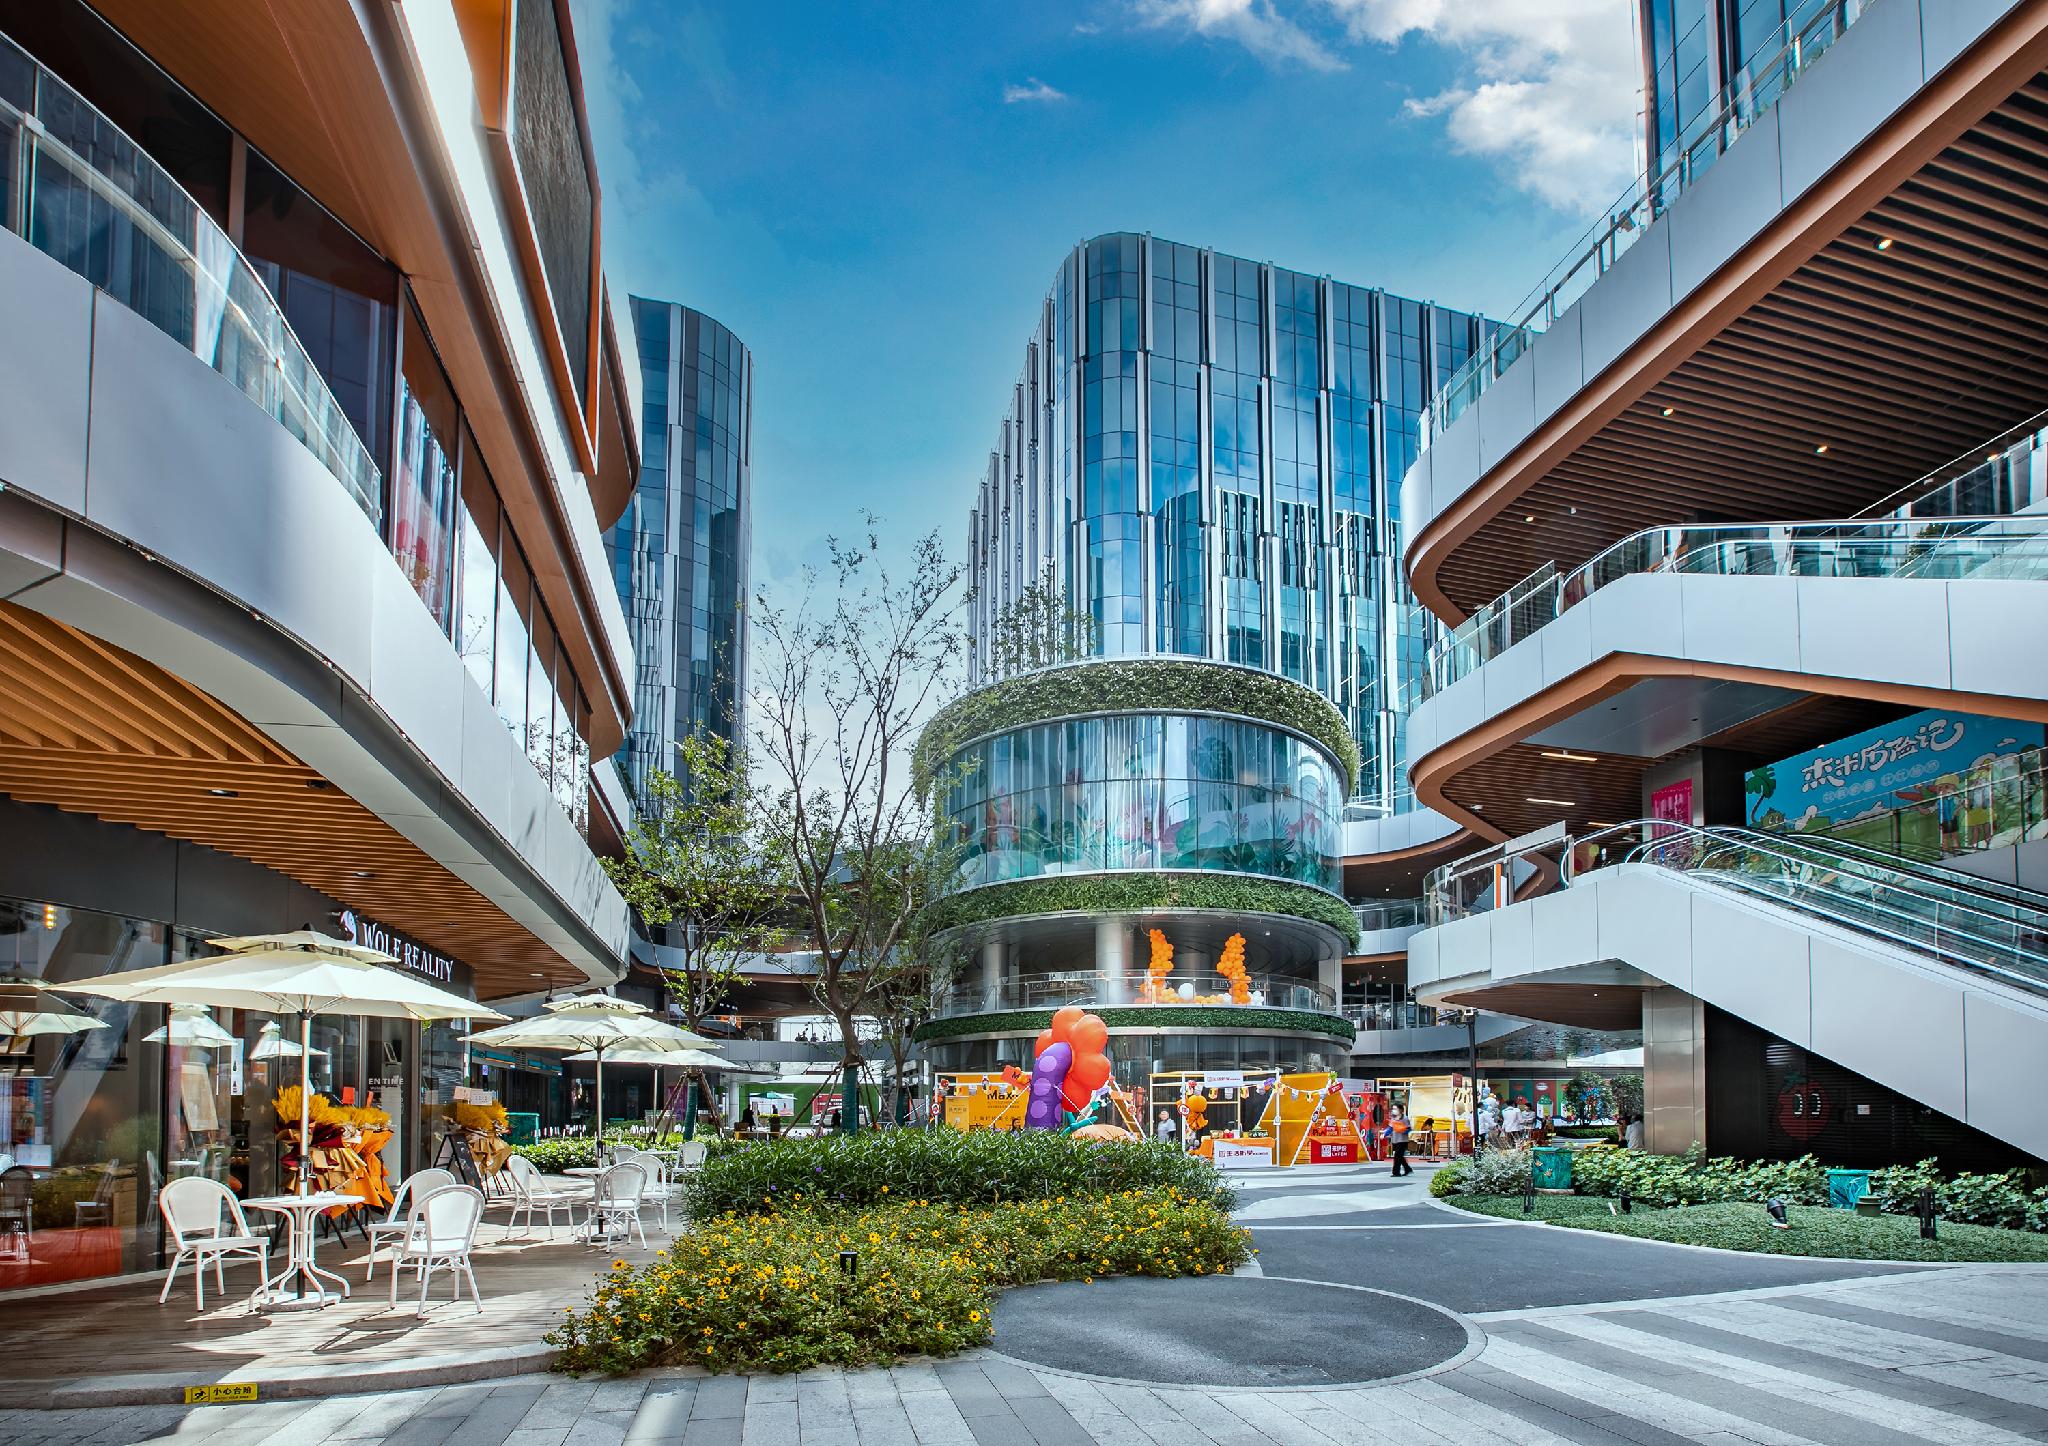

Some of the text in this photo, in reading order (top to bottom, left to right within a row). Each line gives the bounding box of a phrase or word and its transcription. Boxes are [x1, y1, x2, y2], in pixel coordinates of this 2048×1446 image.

[1801, 719, 1965, 793] 杰米历险记
[362, 922, 454, 982] WOLF REALITY
